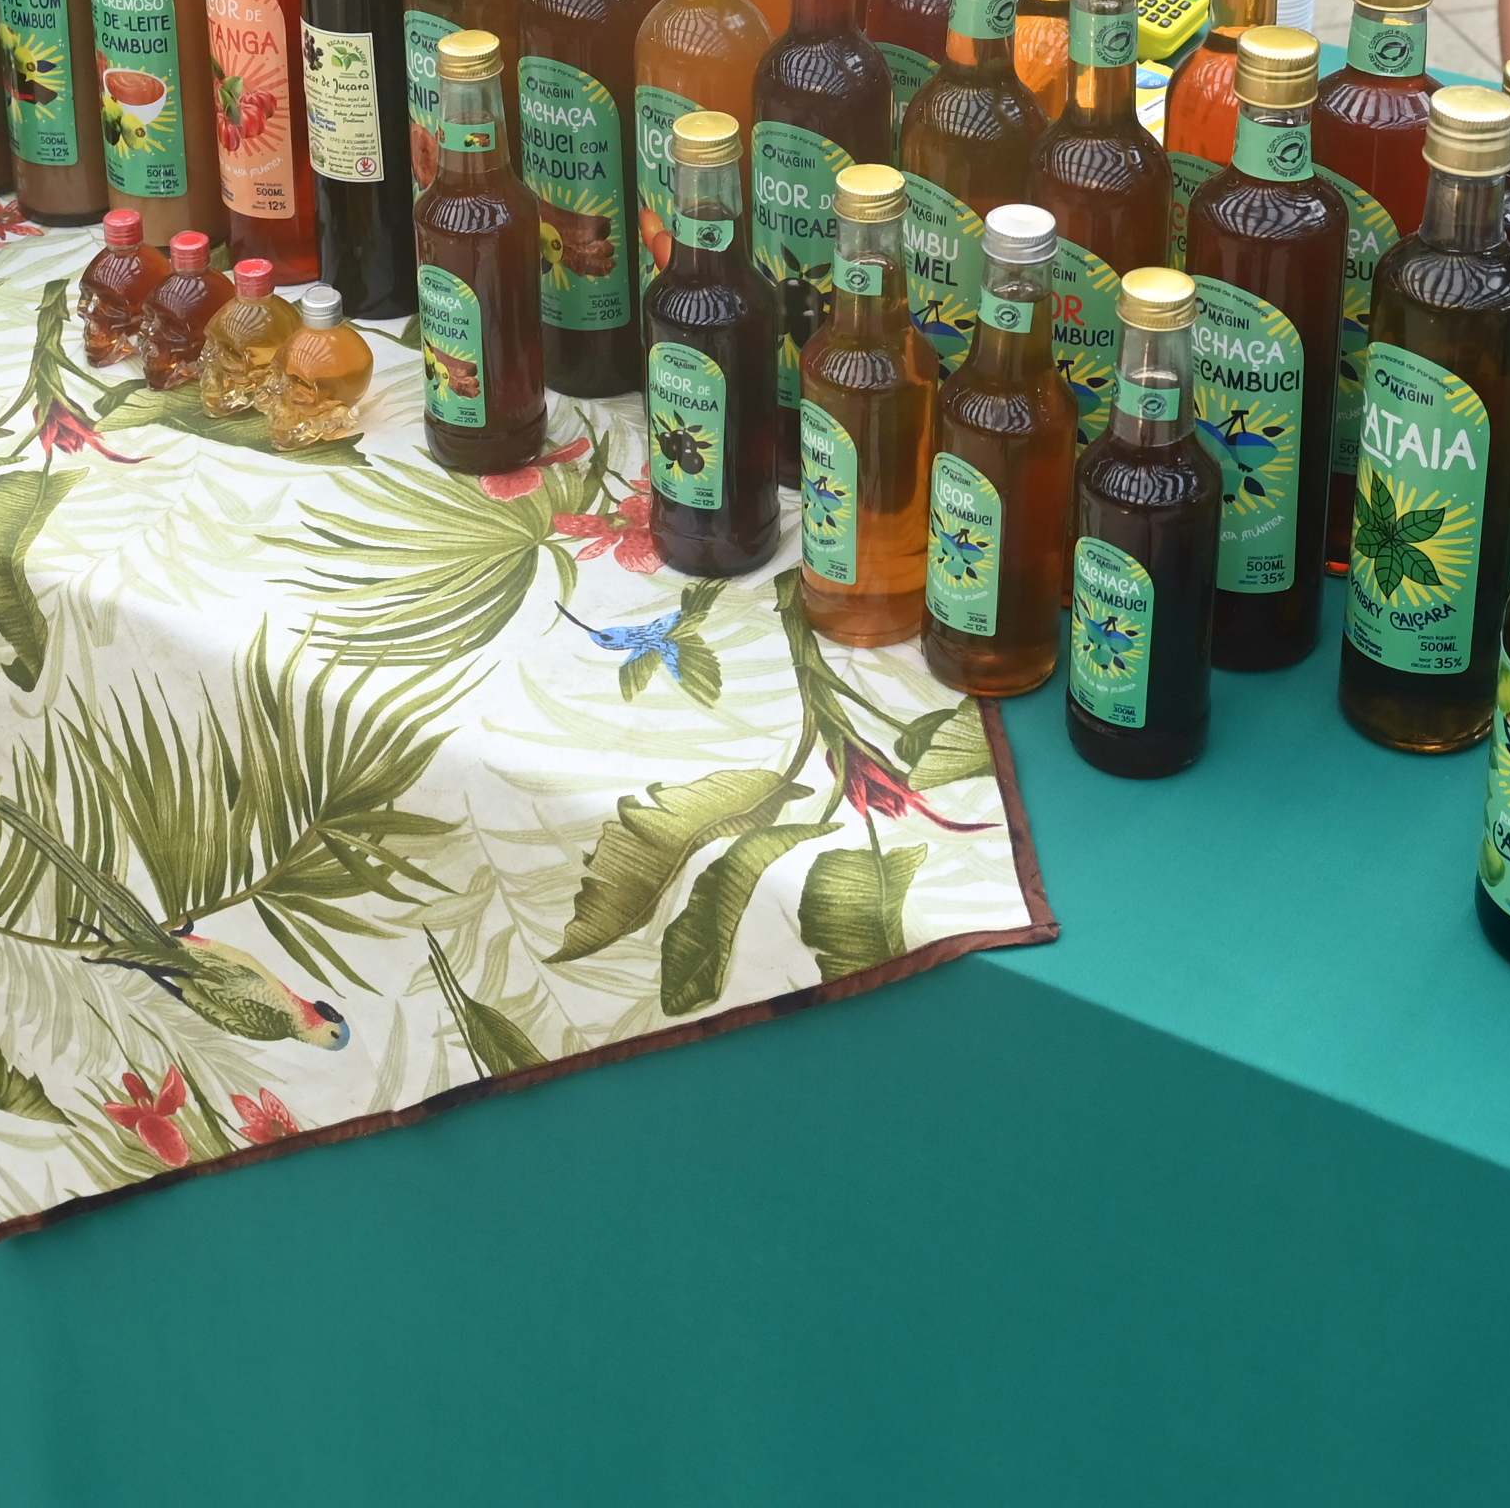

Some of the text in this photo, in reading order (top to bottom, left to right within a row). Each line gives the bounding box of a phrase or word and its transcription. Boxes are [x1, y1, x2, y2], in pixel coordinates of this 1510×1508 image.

[11, 12, 56, 29] CAMBUCI
[104, 11, 171, 32] DE LEITE
[245, 9, 262, 22] DE
[209, 20, 279, 56] TANGA
[1095, 19, 1120, 45] Cambuci
[102, 33, 168, 54] CAMBUCI
[322, 75, 330, 88] de
[333, 78, 369, 94] Juçara
[539, 83, 574, 99] MAGINI
[893, 74, 921, 87] AGINI
[409, 79, 439, 113] ENIP
[520, 93, 597, 133] CACHAÇA
[41, 137, 68, 145] 500ML
[520, 120, 608, 154] AMBUCI COM
[637, 112, 674, 170] LIC
[1267, 130, 1293, 154] Cambuci
[52, 147, 70, 157] 12%
[777, 156, 815, 169] MAGINI
[522, 147, 607, 181] APADURA
[256, 188, 285, 196] 500ML
[753, 167, 811, 210] LICOR
[268, 201, 286, 210] 12%
[912, 204, 947, 226] MAGINI
[753, 200, 837, 238] ABUTICAB
[903, 219, 959, 261] AMBU
[914, 254, 958, 286] MEL
[1052, 268, 1076, 283] GINI
[420, 301, 470, 326] AMBUCI COM
[591, 298, 622, 308] 500ML
[1208, 301, 1234, 314] Recanto
[599, 309, 622, 321] 20%
[1208, 309, 1250, 330] MAGINI
[421, 316, 468, 340] APADURA
[1052, 324, 1114, 346] MBUCI
[1192, 323, 1285, 371] ACHAÇA
[655, 366, 711, 395] LICOR DE
[1199, 359, 1300, 393] CAMBUCI
[1391, 375, 1417, 389] Recanto
[1406, 363, 1455, 395] de Parelheiros
[650, 381, 719, 412] JABUTICABA
[1390, 383, 1434, 406] MAGINI
[811, 448, 835, 470] MEL
[935, 470, 975, 512] LICOR
[946, 503, 992, 527] CAMBUCI
[1241, 513, 1285, 542] ATLÂNTICA
[1078, 555, 1140, 597] CACHAÇA
[1246, 560, 1286, 572] 500ML
[1260, 572, 1285, 585] 35%
[1089, 584, 1147, 612] CAMBUCI
[1390, 603, 1457, 632] CAIÇARA
[1420, 642, 1458, 652] 500ML
[1434, 656, 1462, 668] 35%
[1120, 715, 1136, 724] 35%
